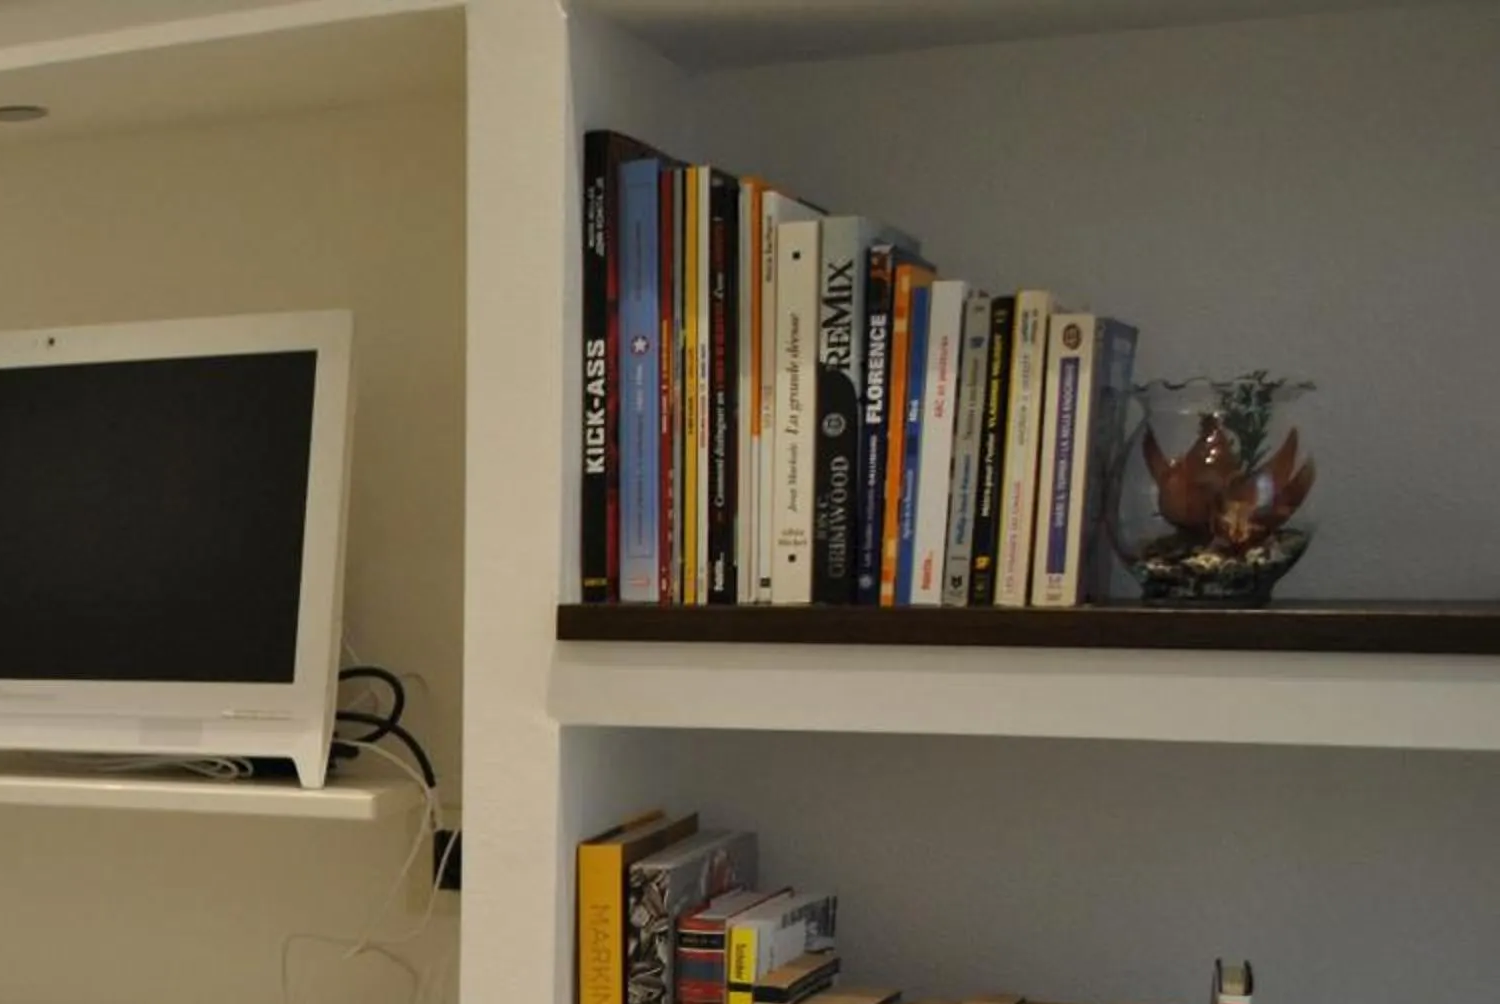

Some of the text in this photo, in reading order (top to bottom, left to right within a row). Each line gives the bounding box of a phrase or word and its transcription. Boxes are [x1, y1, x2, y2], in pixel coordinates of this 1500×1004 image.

[585, 338, 606, 475] KICK-ASS
[865, 314, 887, 424] FLORENCE
[828, 455, 850, 578] GRIMWOOD
